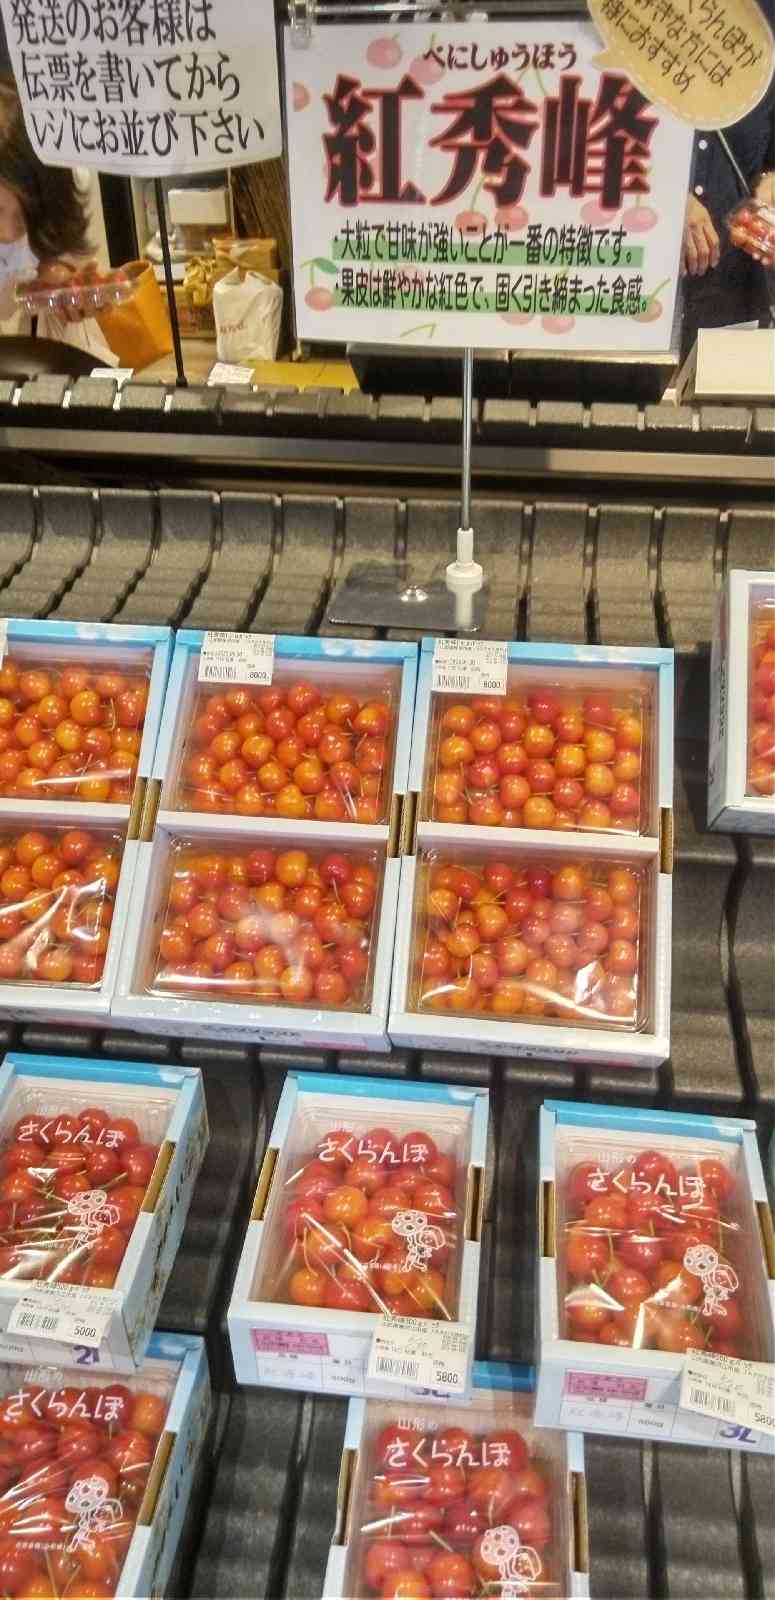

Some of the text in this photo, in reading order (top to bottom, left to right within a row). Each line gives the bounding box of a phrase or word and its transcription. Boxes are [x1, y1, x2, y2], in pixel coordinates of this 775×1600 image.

[10, 0, 216, 47] 発送のお客様は
[422, 41, 578, 71] べにしゅうほう
[20, 50, 241, 103] 伝票を書いてから
[30, 107, 266, 157] レジにお並び下さい
[321, 71, 660, 210] 紅秀峰
[18, 1119, 126, 1148] さくらんぼ
[317, 1137, 429, 1164] さくらんぼ
[587, 1167, 707, 1199] さくらんぼ
[74, 1326, 96, 1337] 5000
[436, 1370, 459, 1384] 5800
[6, 1388, 125, 1421] さくらんぼ
[386, 1436, 512, 1467] さくらんぼ
